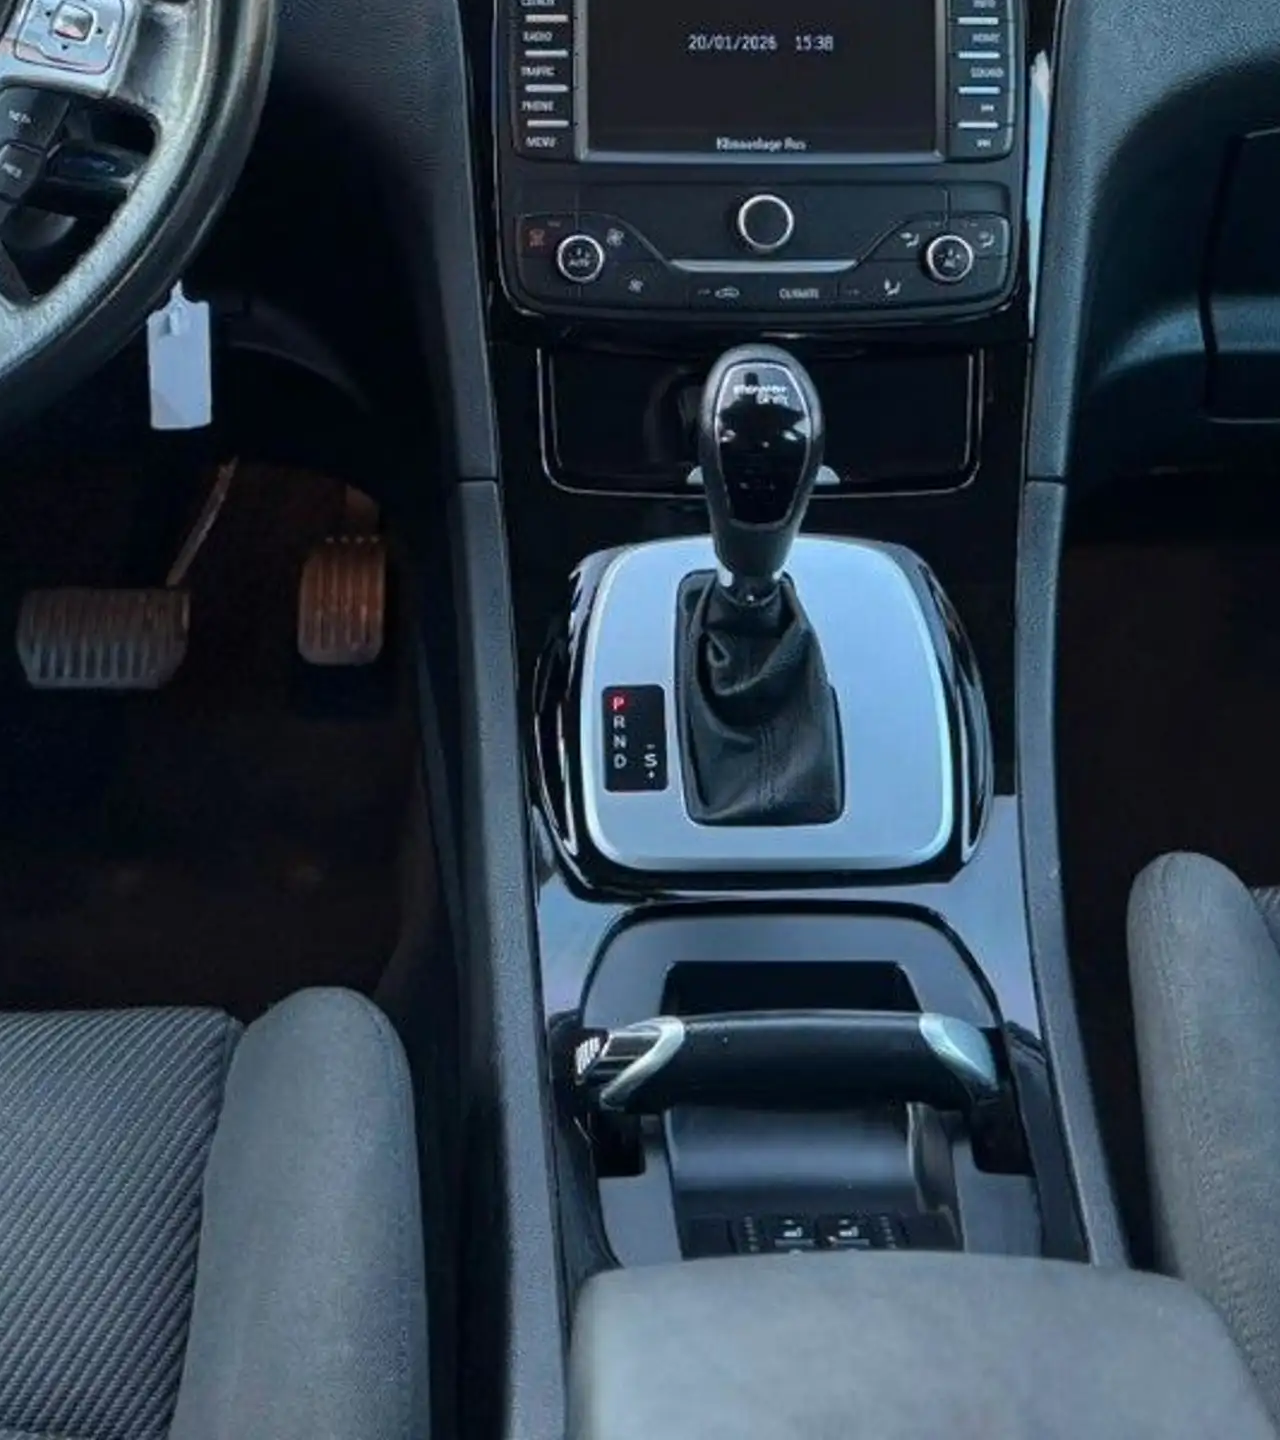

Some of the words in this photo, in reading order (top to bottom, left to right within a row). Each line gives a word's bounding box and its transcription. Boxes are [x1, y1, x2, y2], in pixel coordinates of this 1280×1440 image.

[523, 31, 552, 42] RADIO
[795, 34, 835, 51] 15:38
[525, 136, 557, 147] MENU
[612, 695, 625, 711] P
[613, 714, 626, 729] R
[613, 734, 627, 749] N
